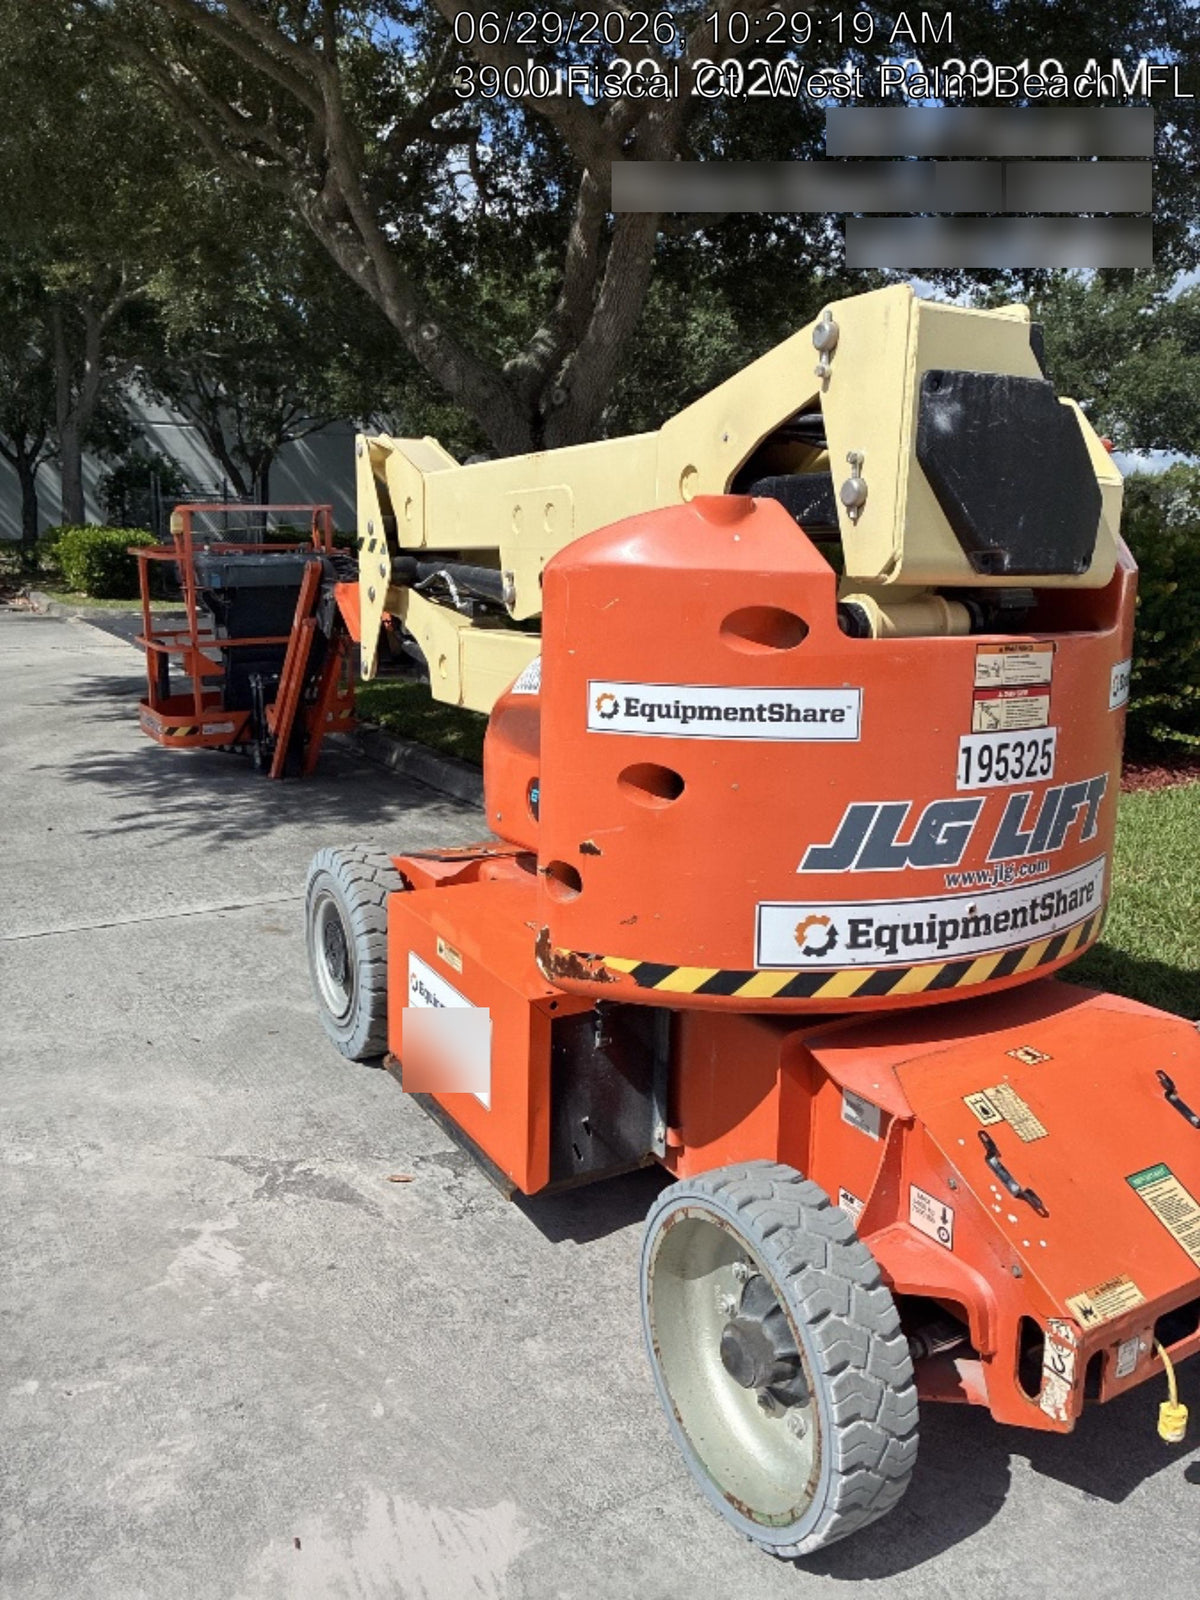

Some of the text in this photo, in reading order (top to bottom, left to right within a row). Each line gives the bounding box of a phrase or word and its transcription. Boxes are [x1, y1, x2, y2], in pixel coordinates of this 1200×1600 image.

[623, 696, 846, 724] EquipmentShare
[961, 737, 1054, 785] 195325
[796, 772, 1110, 874] JLG LIFT
[943, 858, 1050, 888] www.jlg.com
[846, 879, 1096, 956] EquipmentShare
